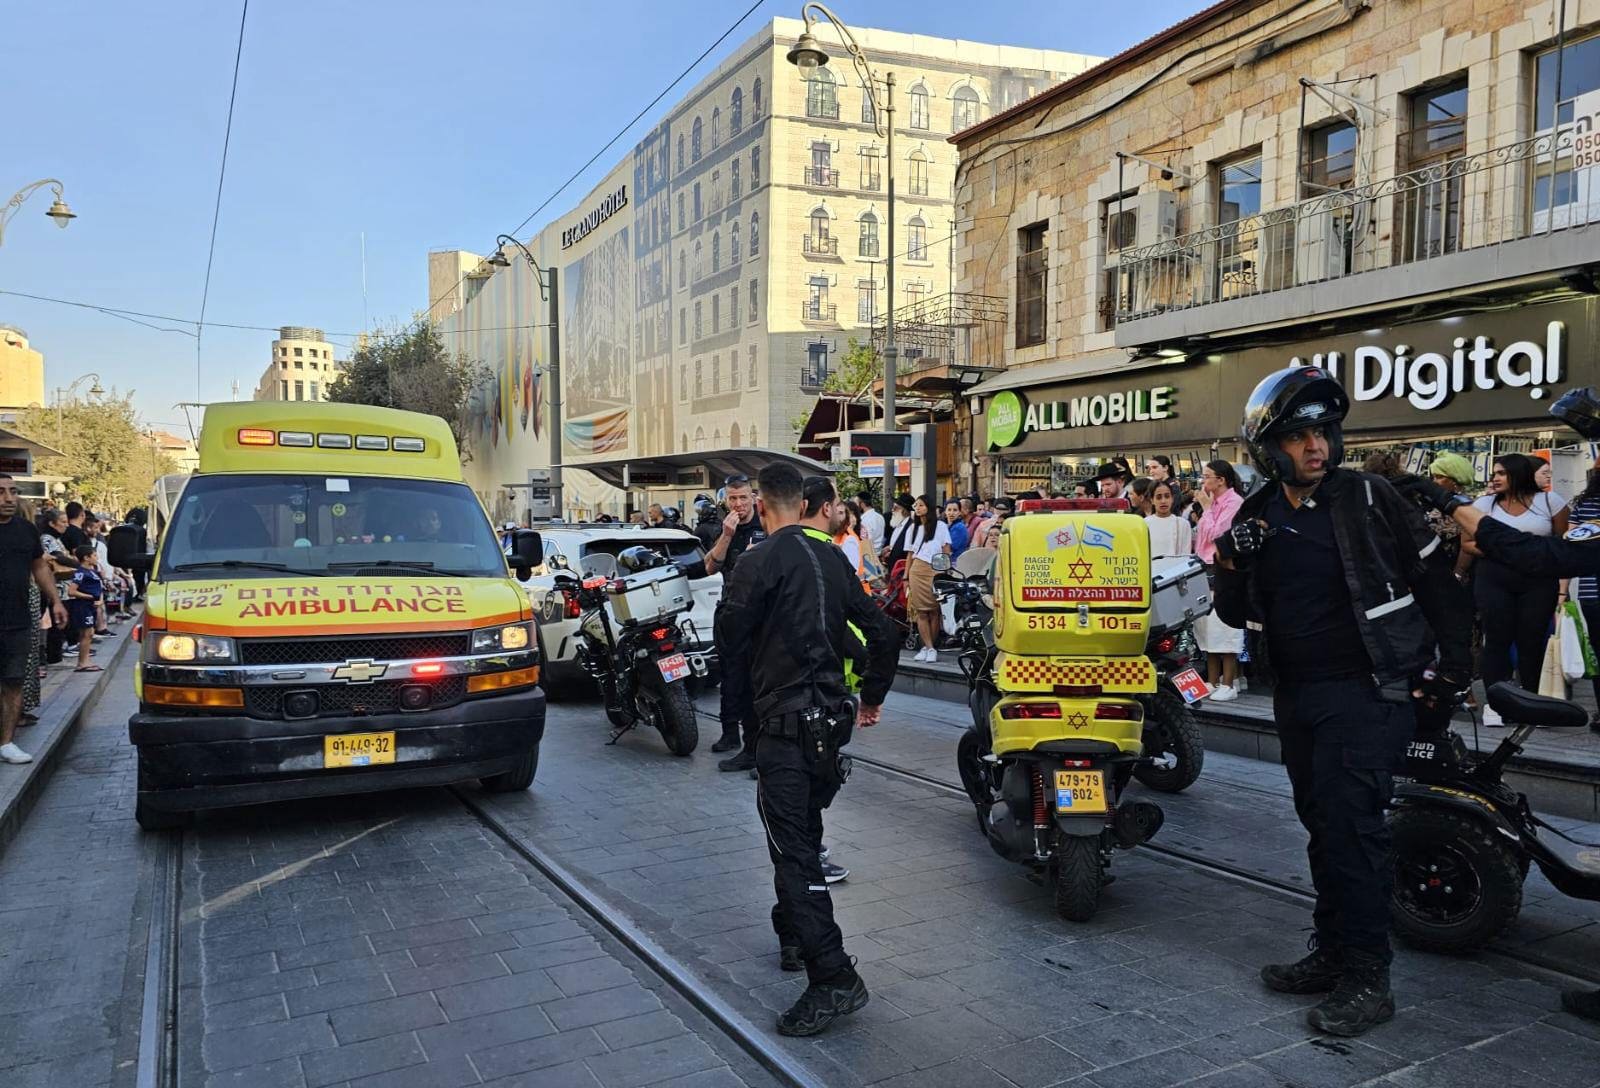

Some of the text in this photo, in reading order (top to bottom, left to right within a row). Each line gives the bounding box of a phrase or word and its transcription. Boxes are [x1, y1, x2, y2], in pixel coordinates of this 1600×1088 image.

[1354, 321, 1563, 410] Digital
[1023, 386, 1171, 432] ALL MOBILE
[1103, 557, 1138, 566] מגן דוד
[1113, 567, 1139, 576] אדום
[1100, 576, 1138, 585] בישראל
[238, 585, 463, 600] מגן דוד אדום
[1025, 587, 1140, 600] ארגון ההצלה הלאומי
[171, 594, 222, 612] 1522
[238, 597, 467, 618] AMBULANCE
[1028, 615, 1067, 630] 5134
[1098, 616, 1127, 630] 101
[1406, 749, 1435, 760] LICE
[1059, 774, 1099, 786] 479-79
[1072, 788, 1093, 800] 602
